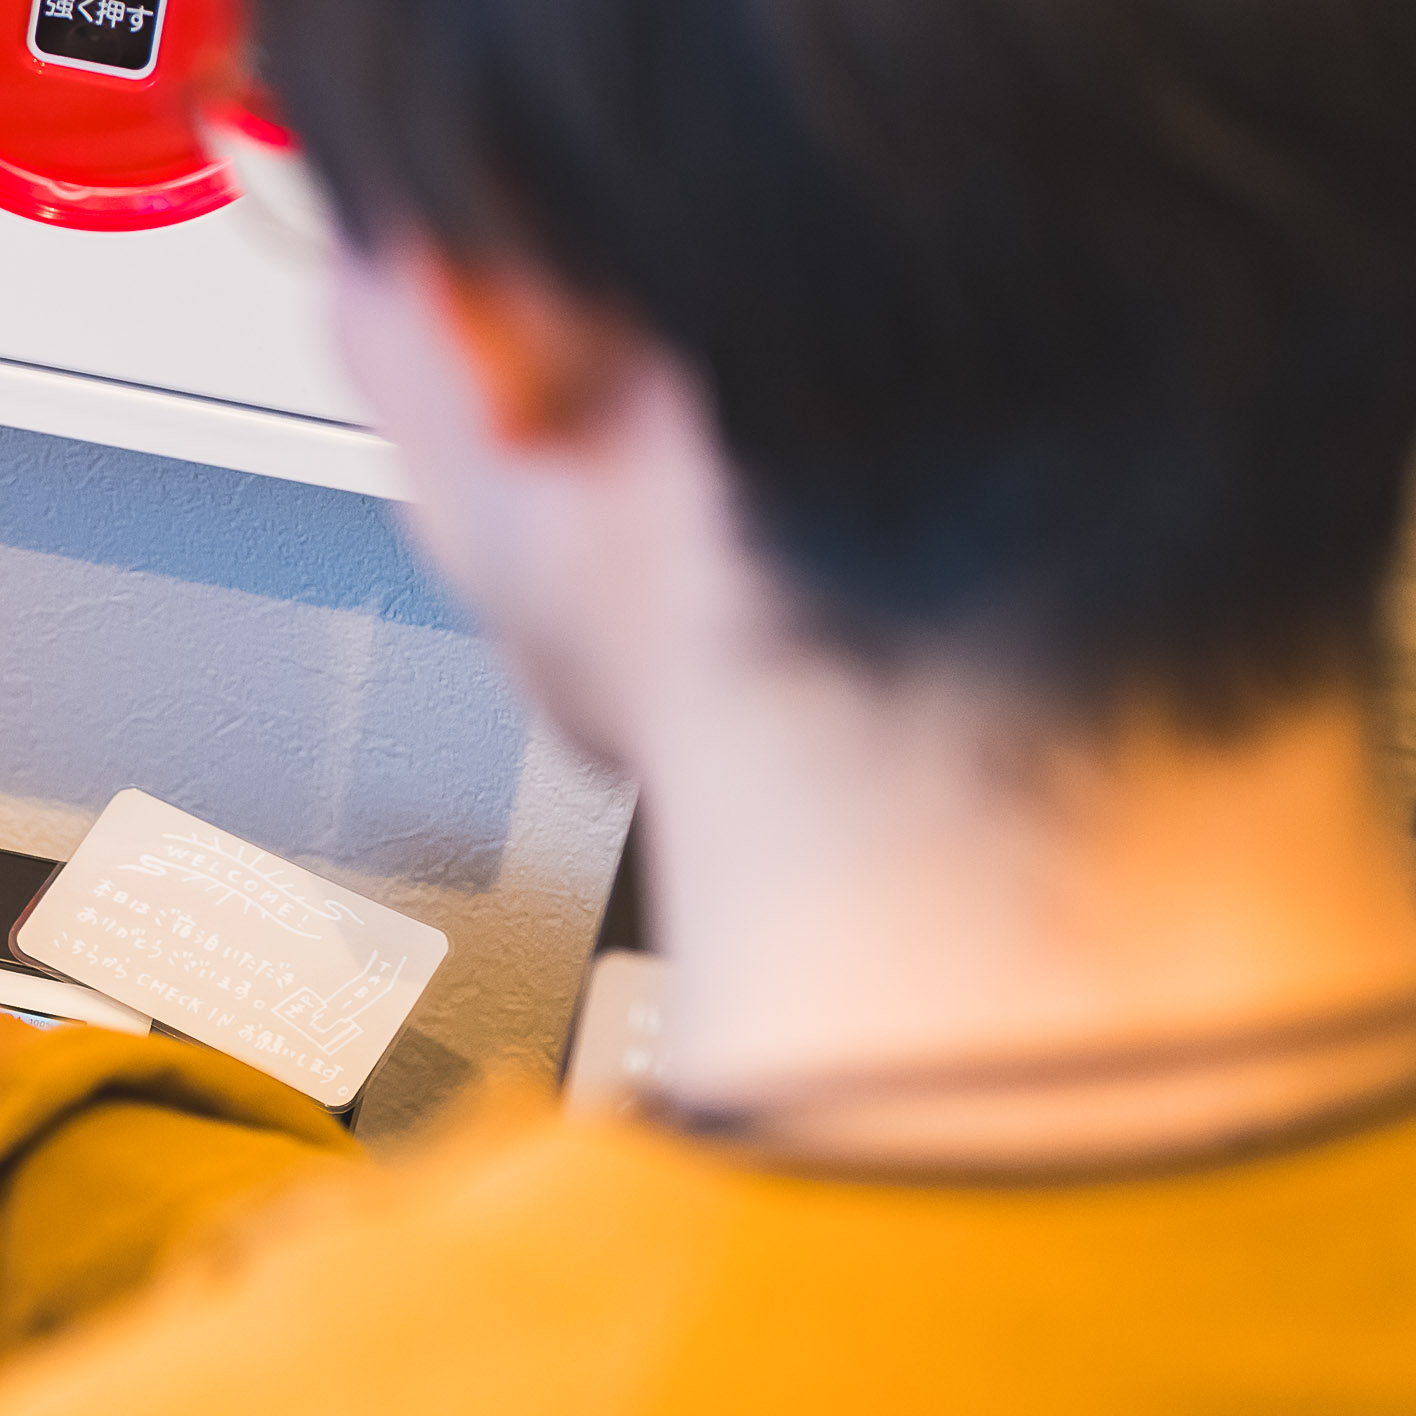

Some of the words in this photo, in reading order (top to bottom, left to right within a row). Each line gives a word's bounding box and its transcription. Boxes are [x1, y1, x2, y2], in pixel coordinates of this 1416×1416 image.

[44, 0, 154, 33] 強く押す
[167, 845, 310, 928] WELCOME!
[136, 972, 206, 1014] CHECK
[207, 1006, 237, 1028] IN
